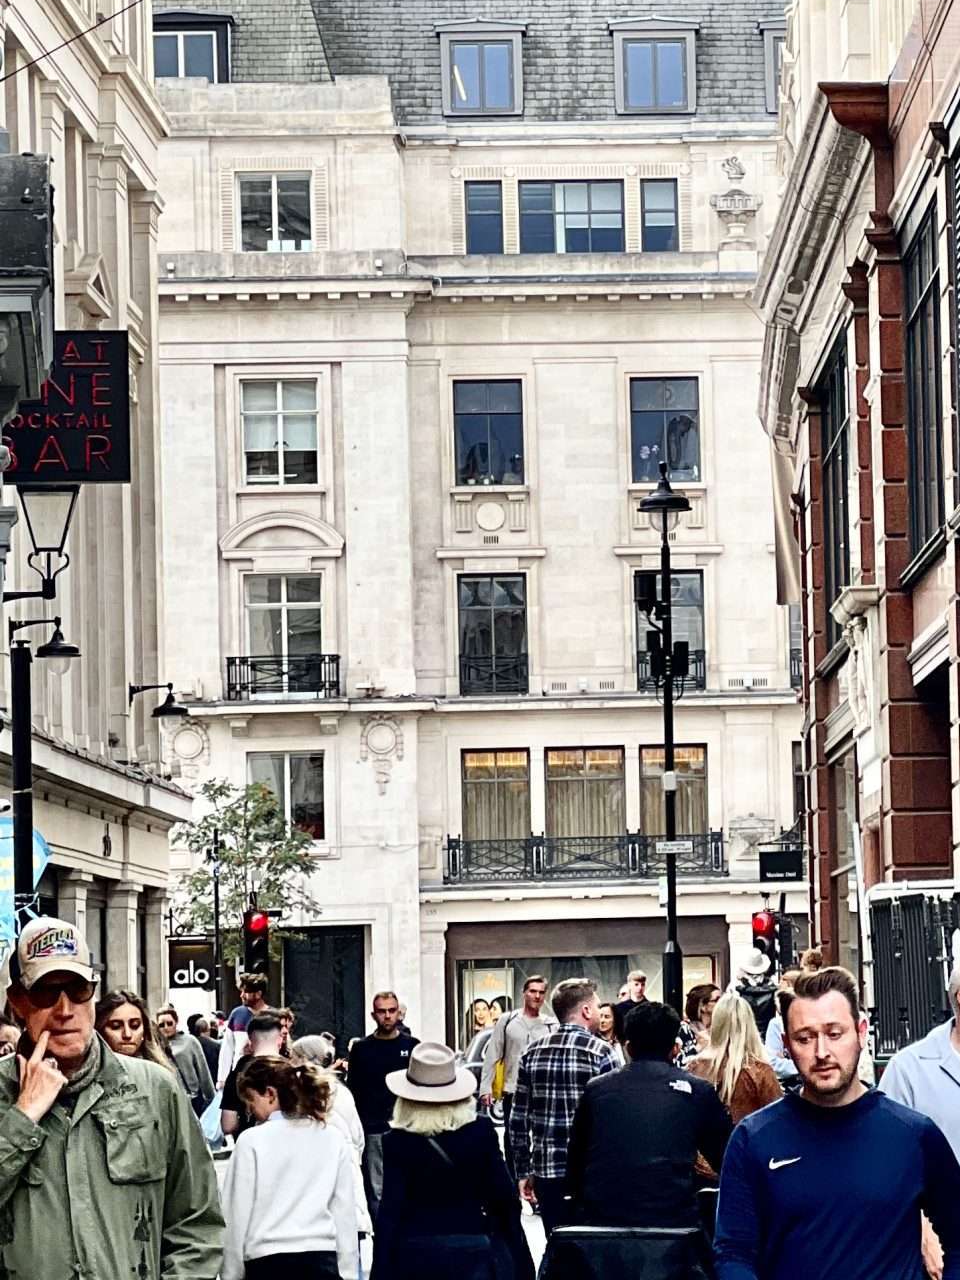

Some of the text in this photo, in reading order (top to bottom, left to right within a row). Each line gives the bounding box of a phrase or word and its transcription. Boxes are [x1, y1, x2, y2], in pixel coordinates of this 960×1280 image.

[41, 372, 112, 406] NE
[10, 412, 112, 429] OCKTAIL
[174, 959, 209, 985] alo
